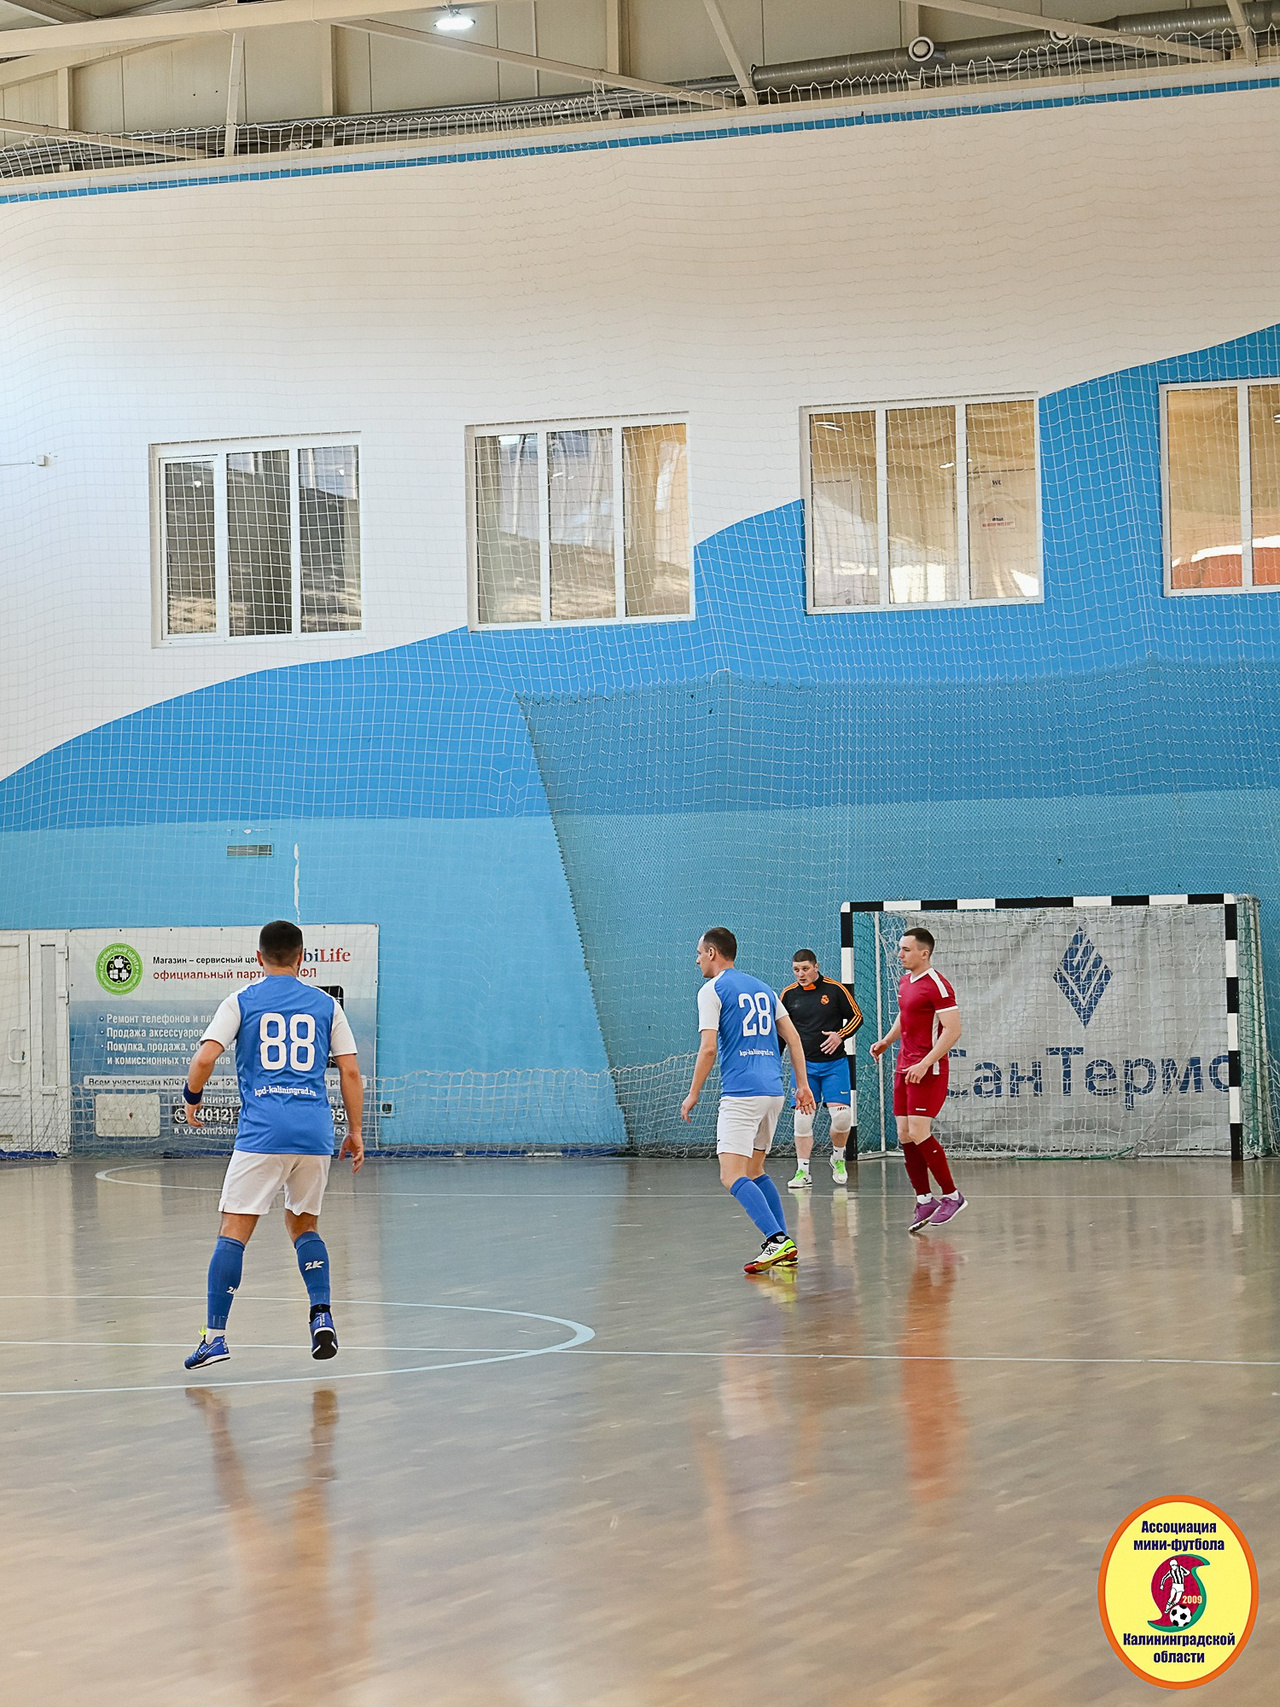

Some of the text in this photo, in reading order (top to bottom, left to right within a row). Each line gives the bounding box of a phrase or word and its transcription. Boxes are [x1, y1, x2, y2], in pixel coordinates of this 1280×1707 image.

[153, 956, 187, 964] Магазин
[196, 956, 243, 965] сервисный
[303, 947, 351, 962] biLife
[153, 969, 233, 981] официальный
[297, 968, 317, 978] ФЛ
[106, 1014, 139, 1023] Ремонт
[141, 1014, 191, 1025] телефонов
[192, 1015, 198, 1023] и
[738, 992, 772, 1037] 28
[106, 1028, 204, 1039] Продажа аксессуаров
[106, 1041, 146, 1053] Покупка,
[147, 1042, 189, 1053] продажа,
[260, 1012, 315, 1072] 88
[106, 1057, 113, 1065] и
[114, 1056, 179, 1065] комиссионных
[88, 1078, 110, 1086] Всем
[254, 1085, 317, 1097] kpd-kaliningrad.ru
